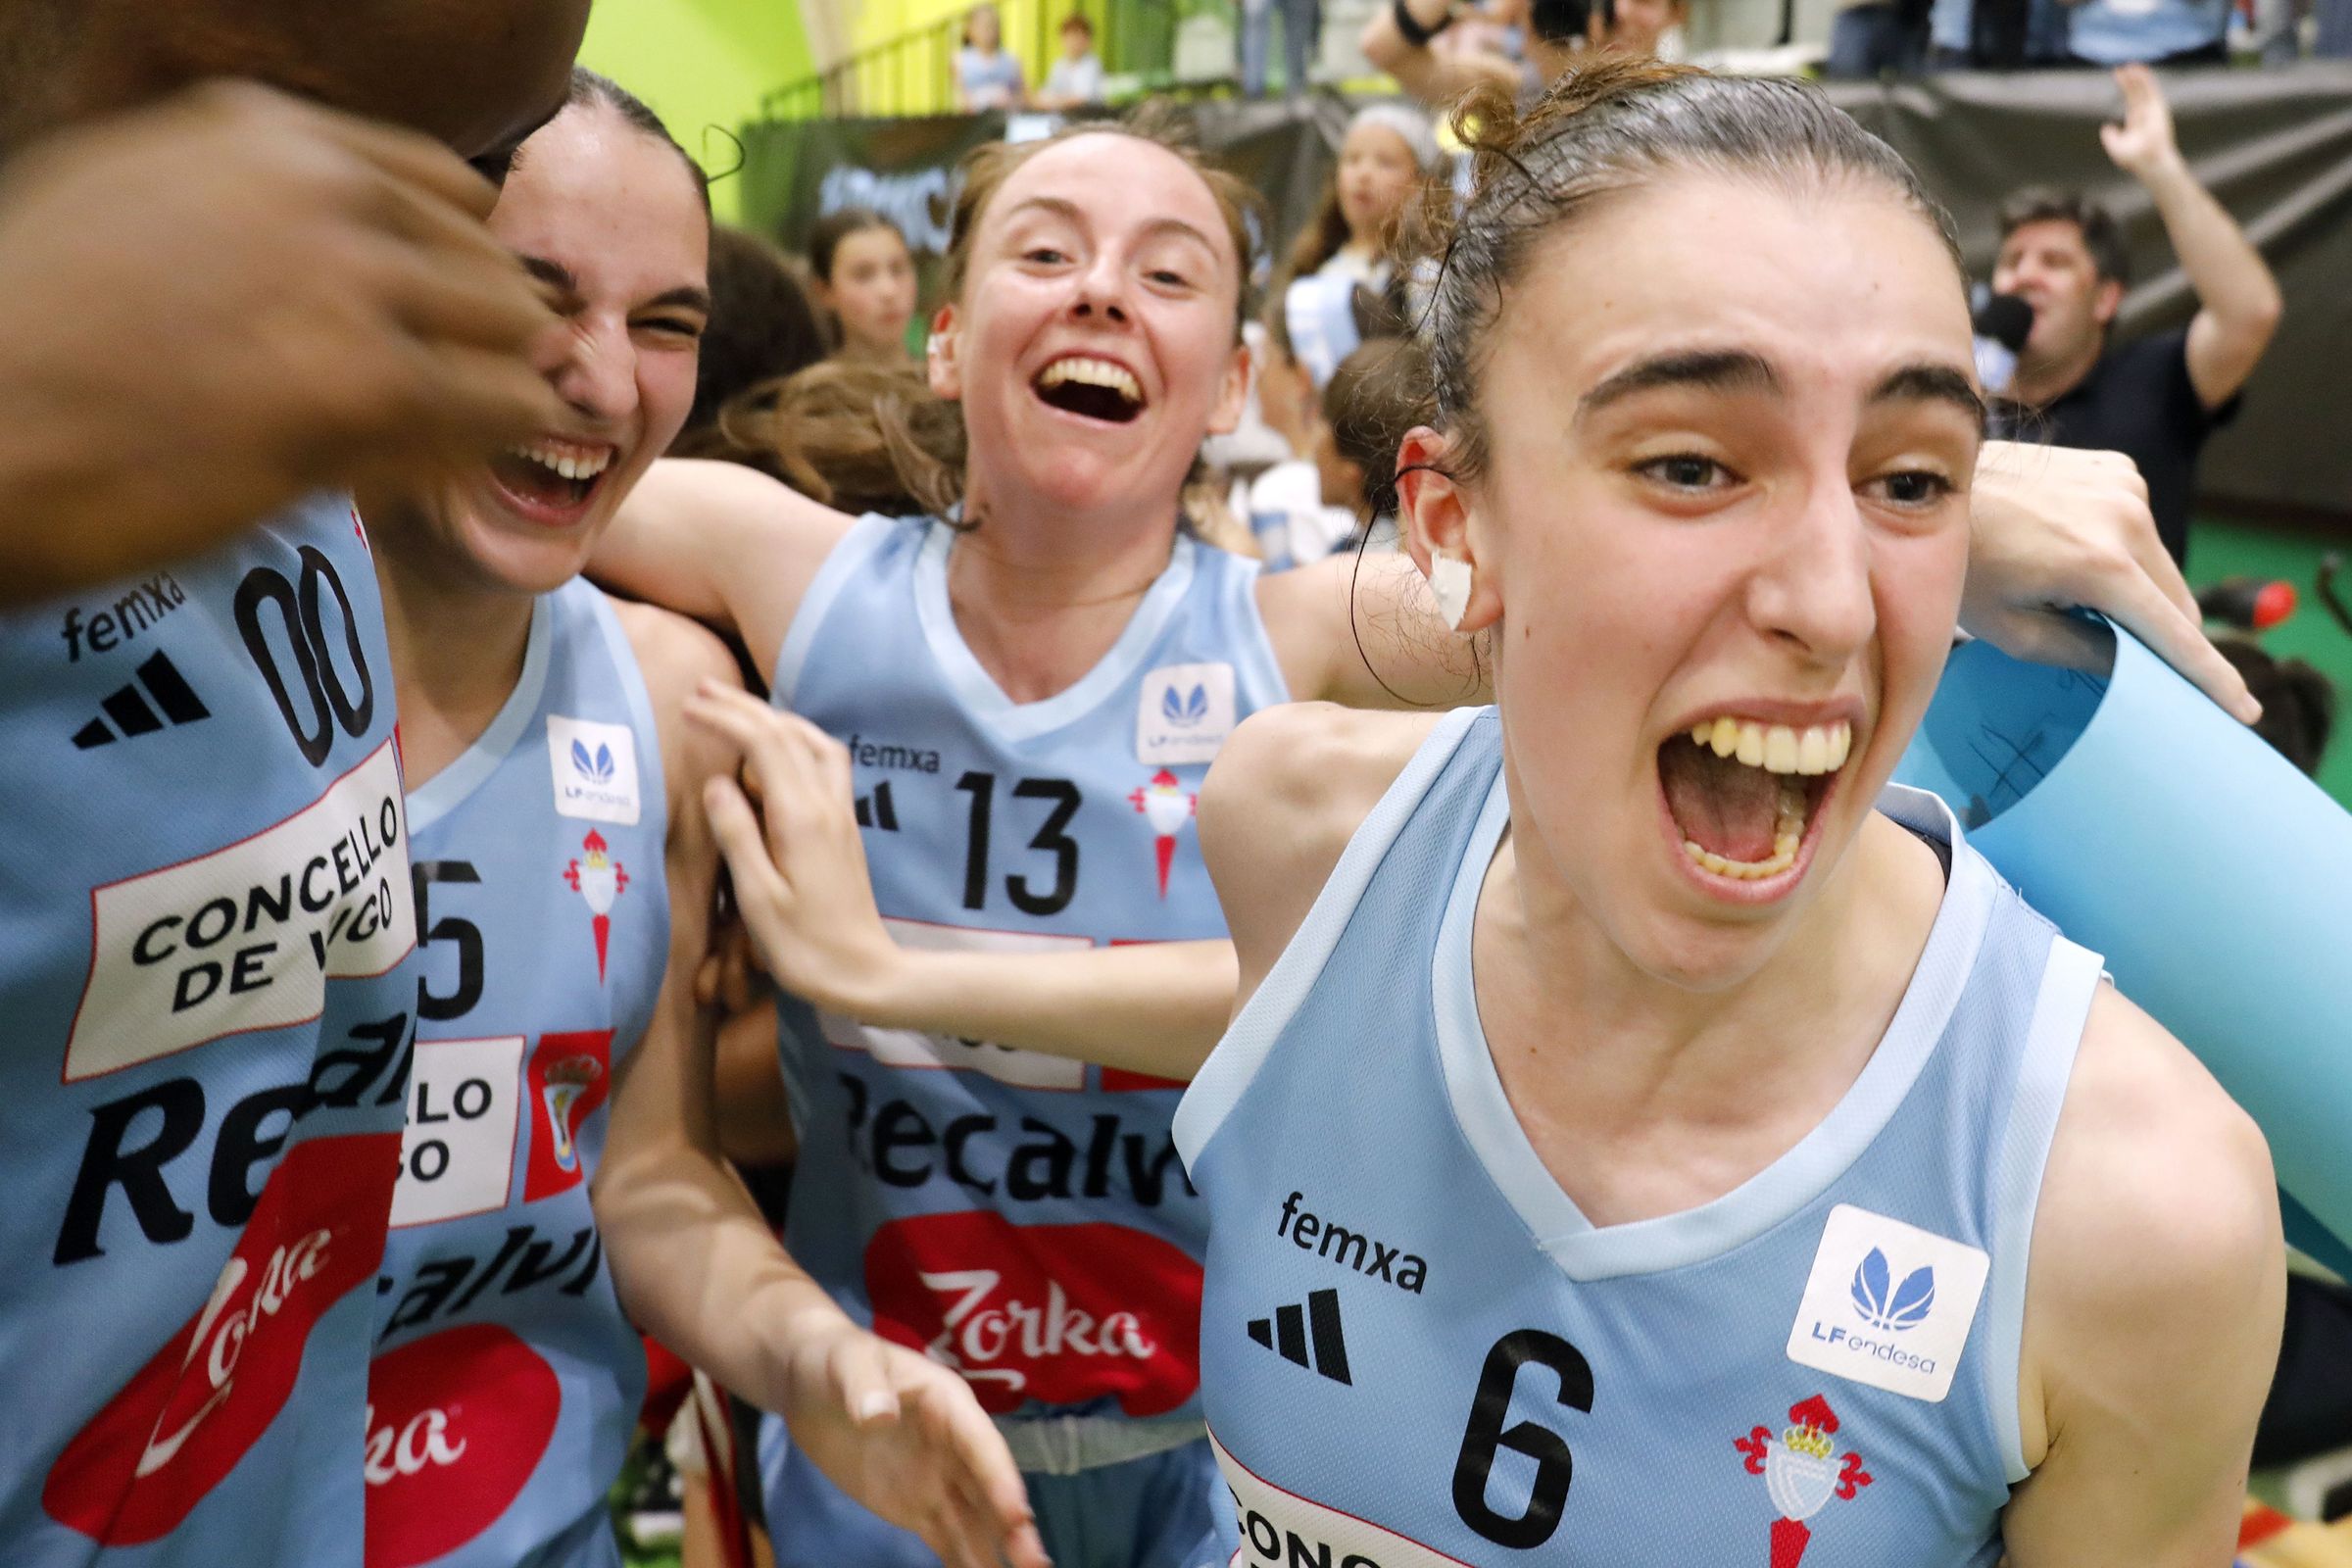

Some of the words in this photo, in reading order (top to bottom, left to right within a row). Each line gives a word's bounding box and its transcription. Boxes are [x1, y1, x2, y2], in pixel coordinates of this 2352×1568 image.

[61, 570, 186, 663] femxa
[233, 544, 373, 767] 00
[132, 796, 397, 965] CONCELLO
[955, 771, 1084, 917] 13
[172, 933, 277, 1003] DE
[412, 860, 483, 1021] 5
[1277, 1191, 1428, 1294] femxa
[919, 1269, 1156, 1392] Zorka
[1452, 1329, 1594, 1549] 6
